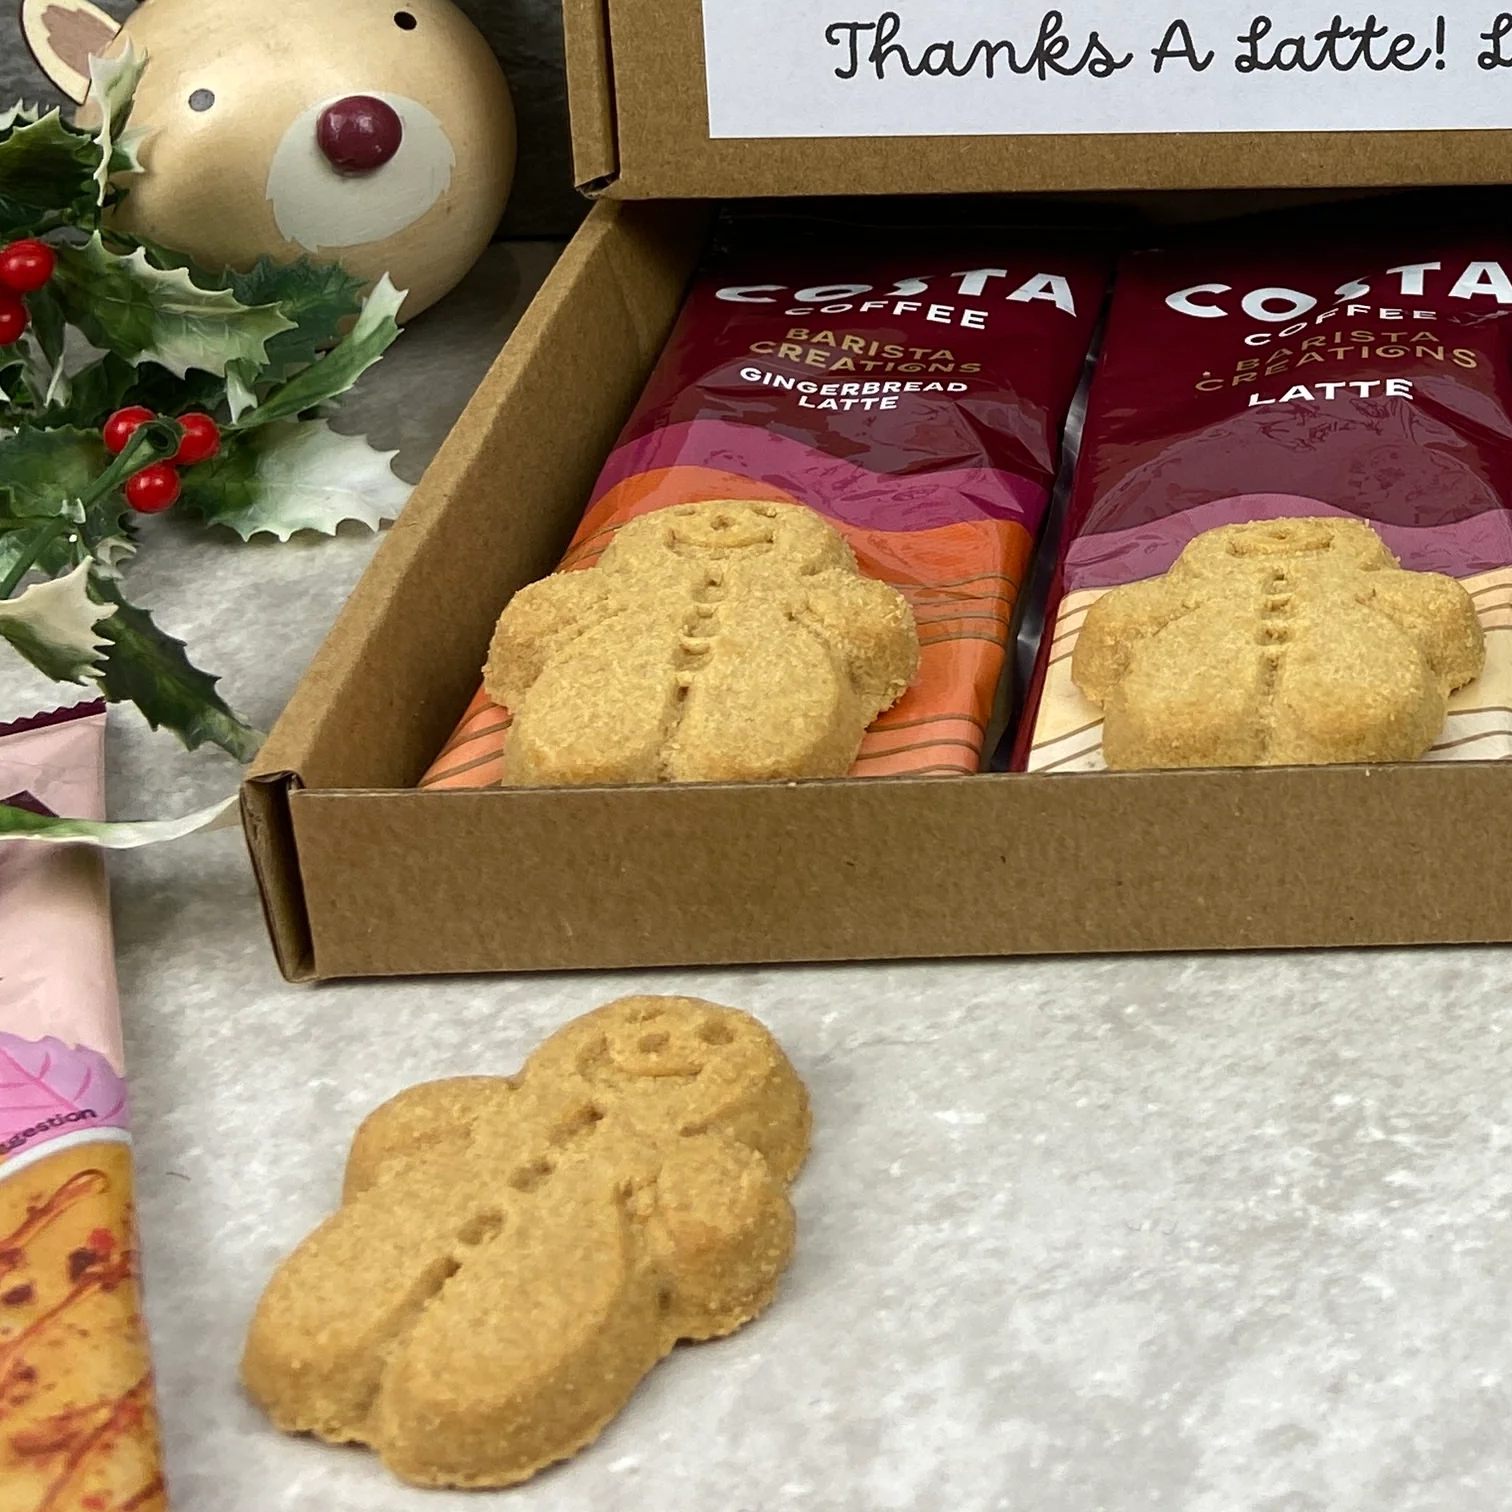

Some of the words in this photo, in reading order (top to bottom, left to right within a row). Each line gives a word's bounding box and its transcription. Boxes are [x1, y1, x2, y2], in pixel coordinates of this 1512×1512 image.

[825, 10, 1134, 80] Thanks
[1150, 18, 1214, 74] A
[1234, 14, 1447, 74] Latte!
[714, 267, 1078, 318] COSTA
[784, 300, 989, 330] COFFEE
[1243, 304, 1438, 347] COFFEE
[749, 340, 983, 374] CREATIONS
[786, 327, 956, 361] BARISTA
[1235, 330, 1441, 372] BARISTA
[739, 367, 969, 398] GINGERBREAD
[1194, 344, 1478, 392] CREATIONS
[797, 394, 900, 413] LATTE
[1248, 377, 1414, 408] LATTE
